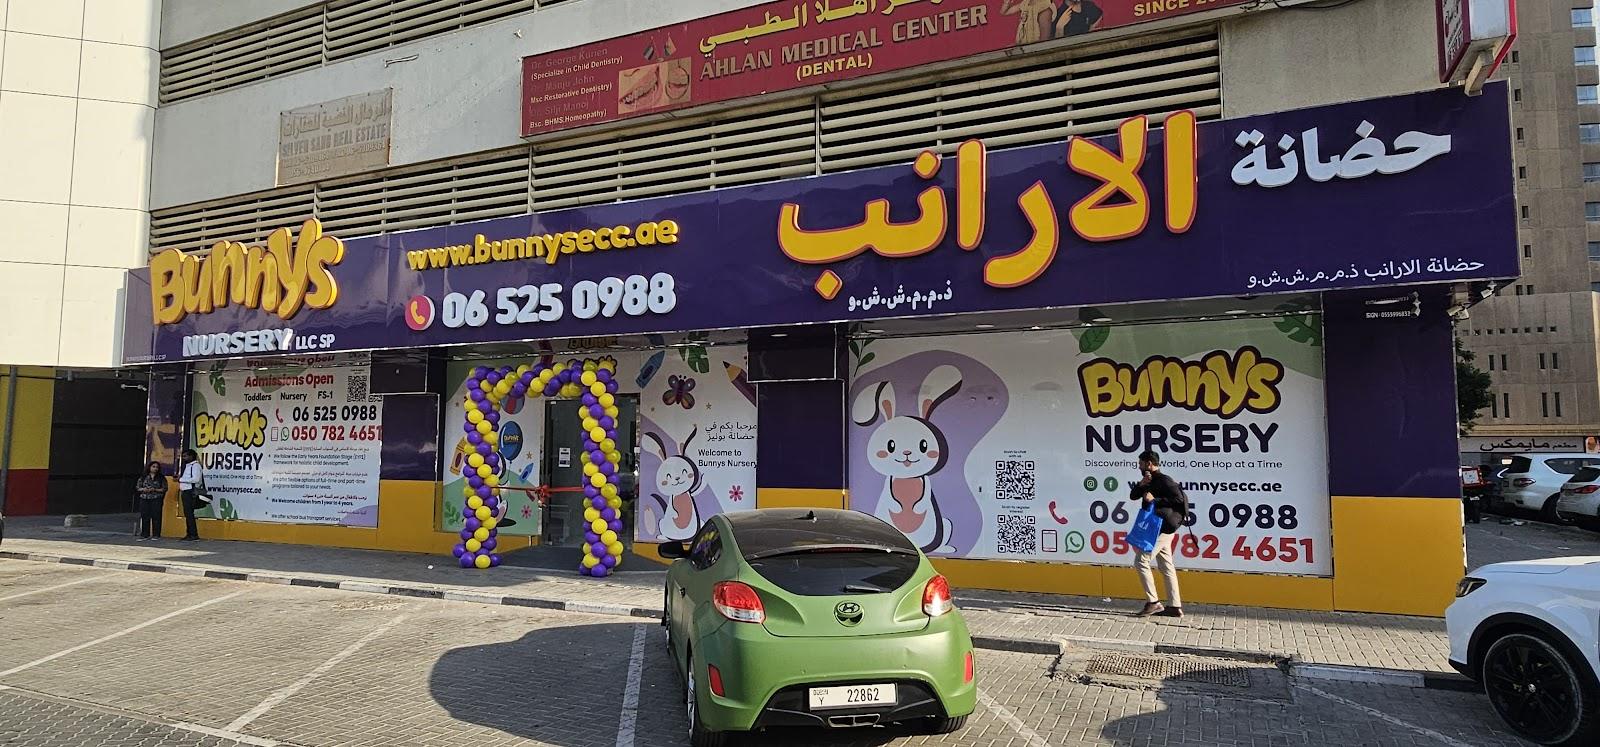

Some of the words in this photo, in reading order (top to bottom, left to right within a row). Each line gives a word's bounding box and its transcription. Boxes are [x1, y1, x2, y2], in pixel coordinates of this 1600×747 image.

[1133, 0, 1190, 17] SINCE
[699, 49, 773, 81] AHLAN
[781, 27, 883, 65] MEDICAL
[892, 4, 988, 43] CENTER
[531, 69, 564, 81] (Specialize
[565, 65, 572, 73] in
[573, 62, 590, 72] Child
[591, 55, 623, 69] Dentistry)
[796, 52, 873, 81] (DENTAL)
[530, 95, 543, 104] Msc
[544, 89, 580, 102] Restorative
[580, 82, 613, 95] Dentistry)
[333, 129, 354, 148] REAL
[355, 122, 388, 143] ESTATE
[1231, 119, 1452, 188] حضانة
[777, 109, 1199, 300] الارانب
[407, 219, 680, 271] www.bunnysecc.ae
[1363, 258, 1421, 281] الارانب
[1427, 256, 1484, 273] حضانة
[442, 289, 489, 329] 06
[496, 282, 564, 325] 525
[572, 272, 677, 320] 0988
[182, 327, 294, 358] NURSERY
[295, 335, 318, 350] LLC
[319, 333, 336, 349] SP
[244, 373, 304, 388] Admissions
[305, 373, 334, 389] Open
[244, 392, 272, 402] Toddlers
[280, 392, 308, 402] Nursery
[318, 390, 333, 399] FS-1
[292, 406, 309, 421] 06
[313, 405, 337, 421] 525
[342, 404, 377, 421] 0988
[291, 425, 318, 441] 050
[322, 425, 345, 441] 782
[349, 425, 383, 441] 4651
[728, 432, 755, 440] حضانة
[736, 421, 758, 431] مرحبا
[1084, 422, 1280, 454] NURSERY
[698, 448, 732, 457] Welcome
[734, 449, 742, 457] to
[698, 459, 726, 469] Bunnys
[727, 459, 757, 469] Nursery
[1085, 459, 1138, 470] Discovering
[1190, 459, 1210, 469] One
[1212, 459, 1232, 471] Hop
[1235, 460, 1246, 469] at
[1247, 461, 1255, 469] a
[1257, 459, 1283, 469] Time
[1089, 500, 1130, 525] 06
[1208, 503, 1299, 530] 0988
[1090, 530, 1138, 556] 05
[1232, 536, 1314, 564] 4651
[818, 696, 825, 706] Y
[847, 687, 880, 703] 22862
